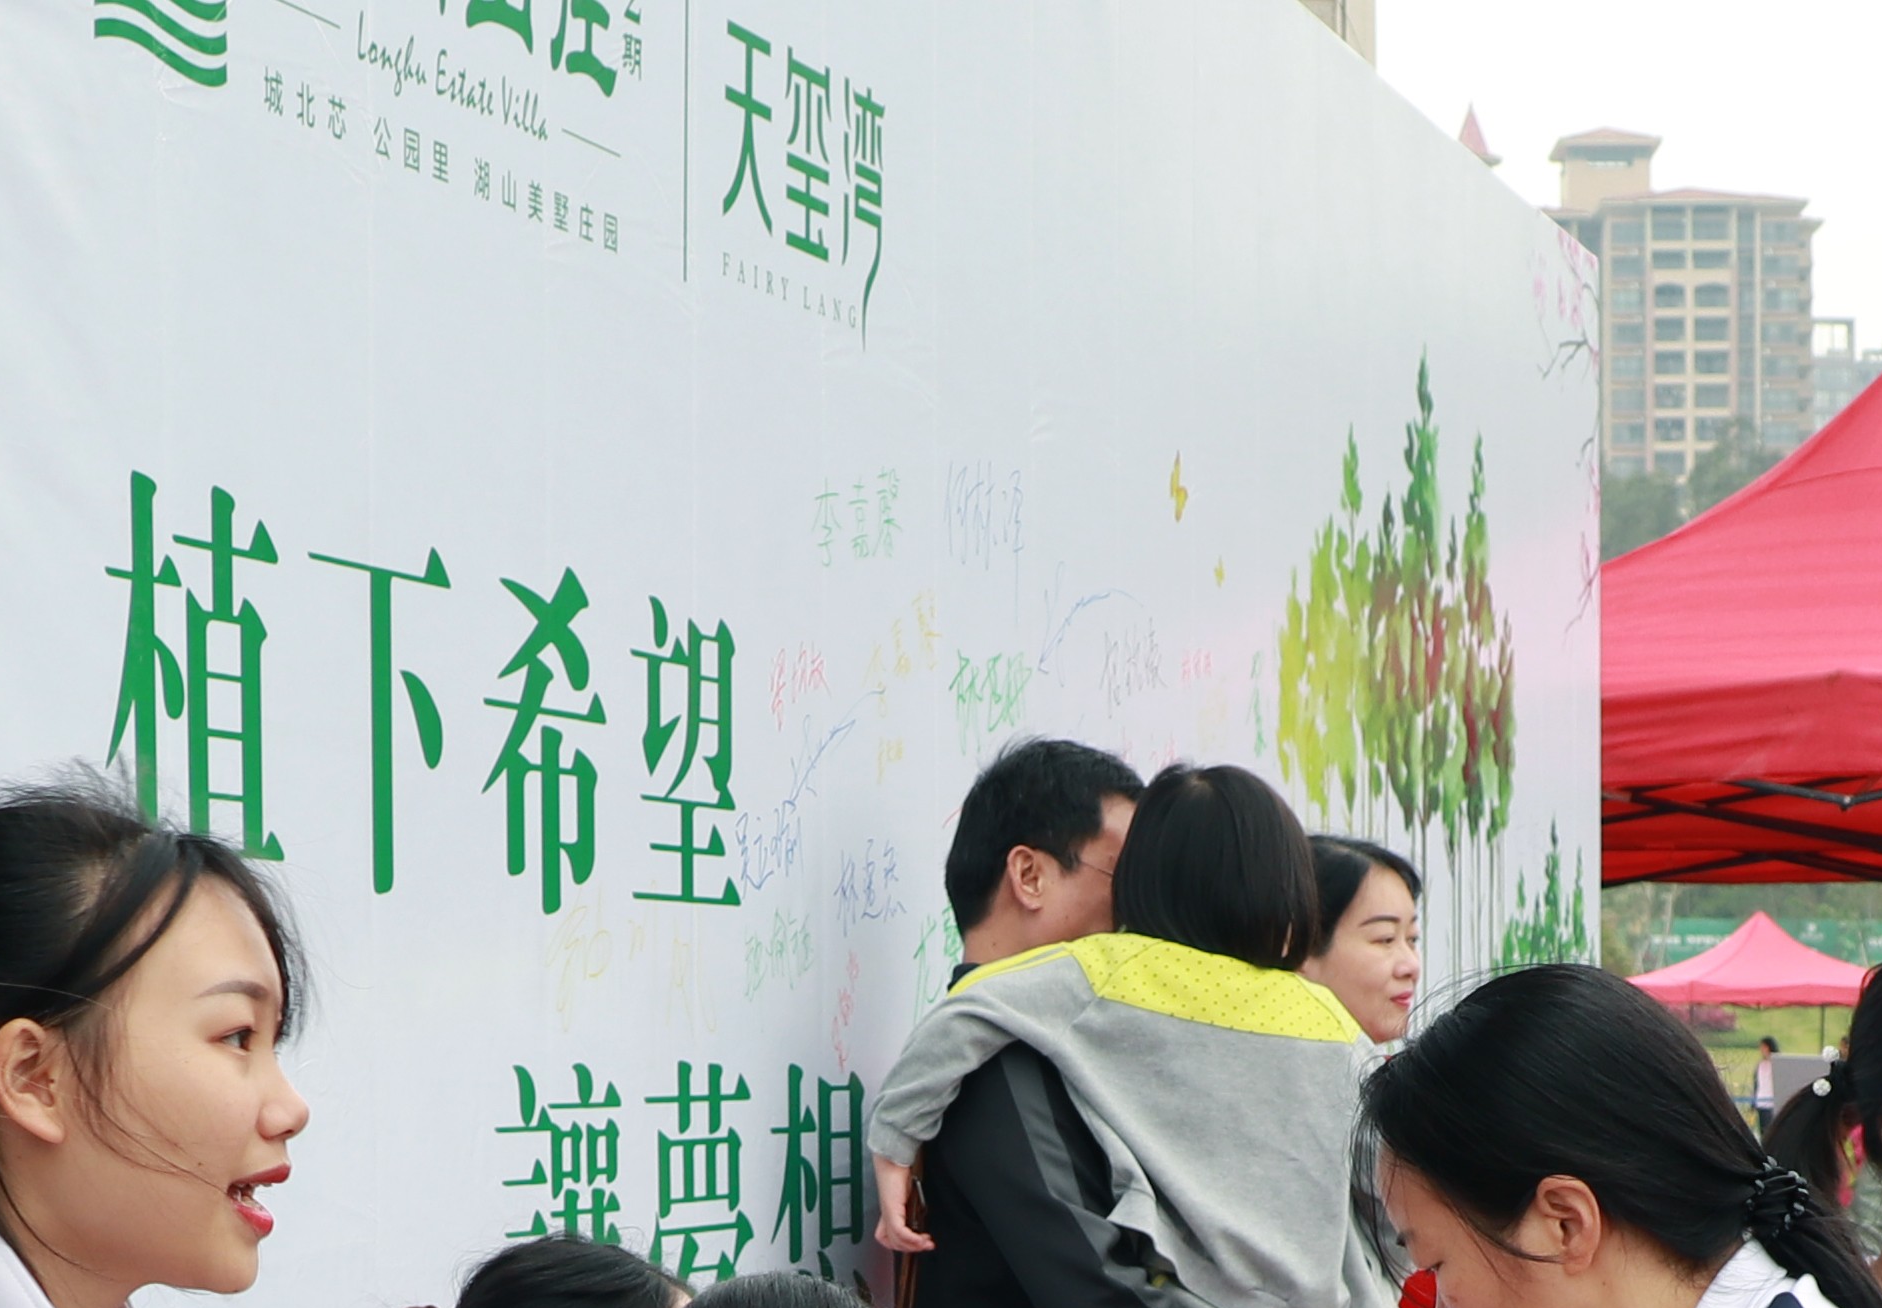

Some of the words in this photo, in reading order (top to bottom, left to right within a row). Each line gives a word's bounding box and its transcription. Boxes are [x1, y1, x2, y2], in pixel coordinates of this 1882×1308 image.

[263, 66, 347, 140] 城北芯
[373, 116, 450, 184] 公园里
[474, 158, 620, 254] 湖山美墅庄园
[357, 10, 428, 96] Longhu
[435, 49, 495, 117] Estate
[501, 76, 549, 142] Villa
[723, 18, 885, 352] 天玺湾
[722, 251, 789, 301] FAIRY
[804, 286, 857, 329] LANG
[103, 470, 742, 915] 植下希望
